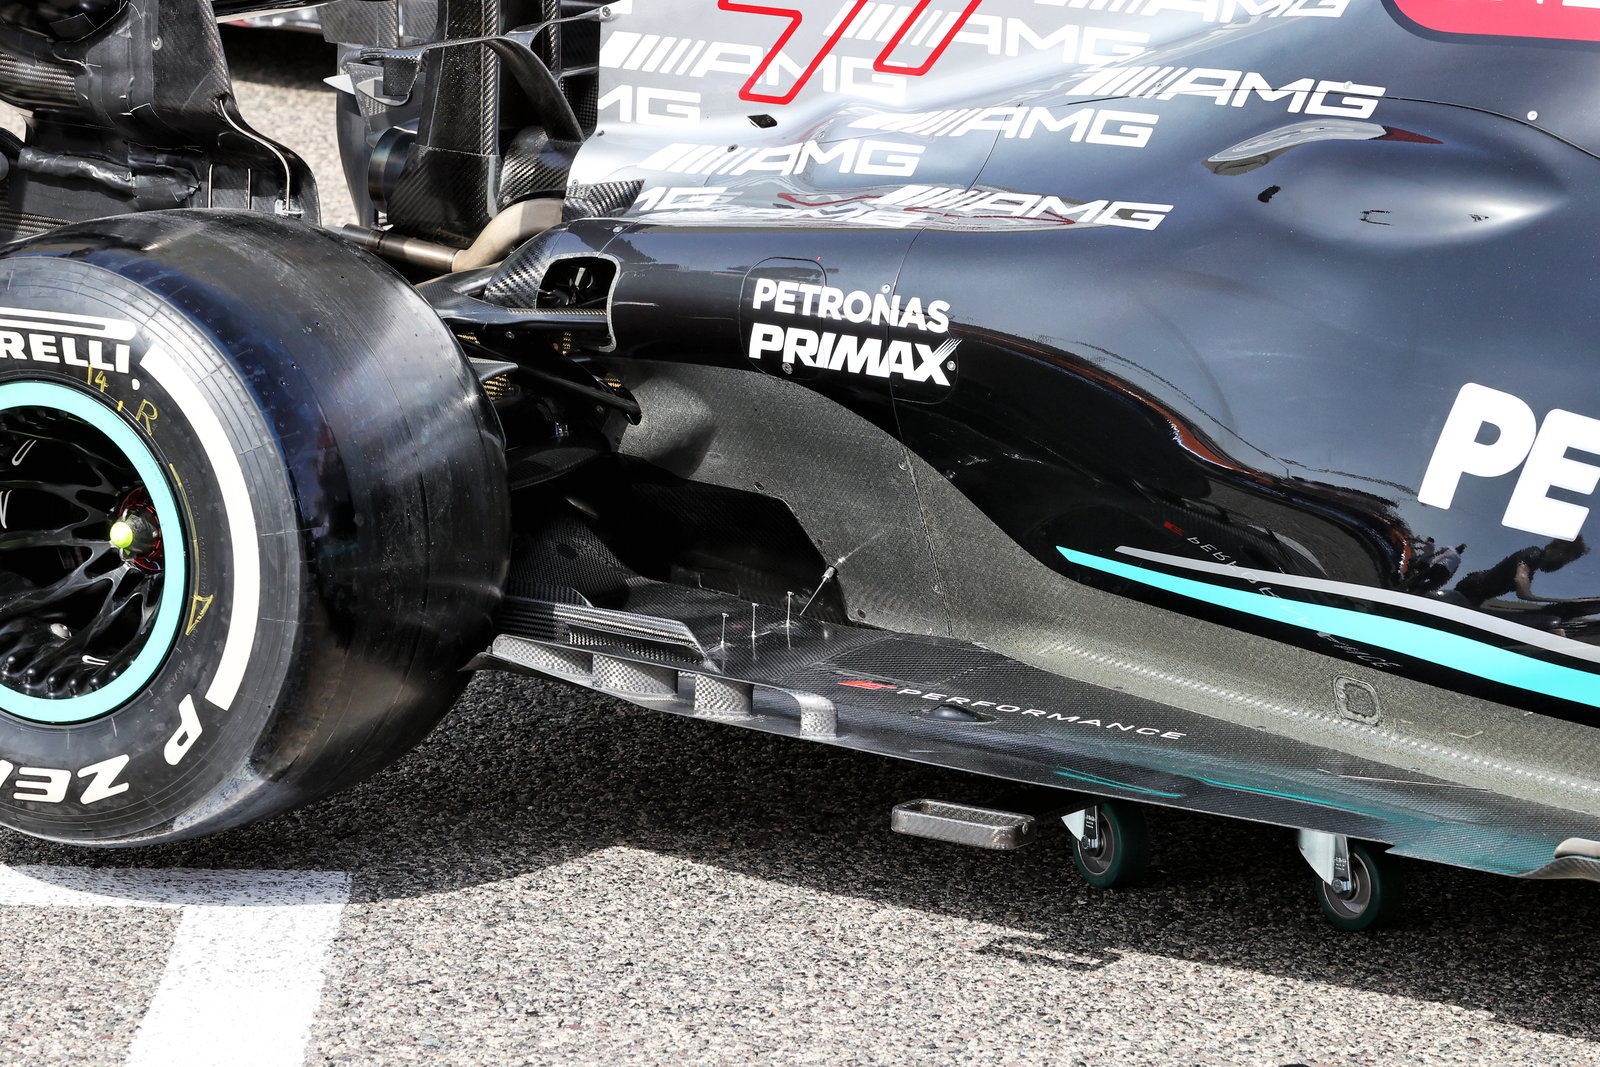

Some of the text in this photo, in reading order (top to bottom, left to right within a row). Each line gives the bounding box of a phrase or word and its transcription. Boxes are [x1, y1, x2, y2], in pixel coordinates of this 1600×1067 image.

[925, 11, 1150, 66] AMG
[690, 41, 908, 103] AMG
[1156, 67, 1386, 119] AMG
[949, 106, 1159, 148] AMG
[729, 138, 926, 177] AMG
[955, 192, 1174, 231] AMG
[752, 278, 951, 333] PETRONAS
[749, 322, 962, 386] PRIMAX
[1417, 382, 1600, 542] PE
[896, 688, 1187, 741] PERFORMANCE
[0, 693, 202, 805] P ZE
